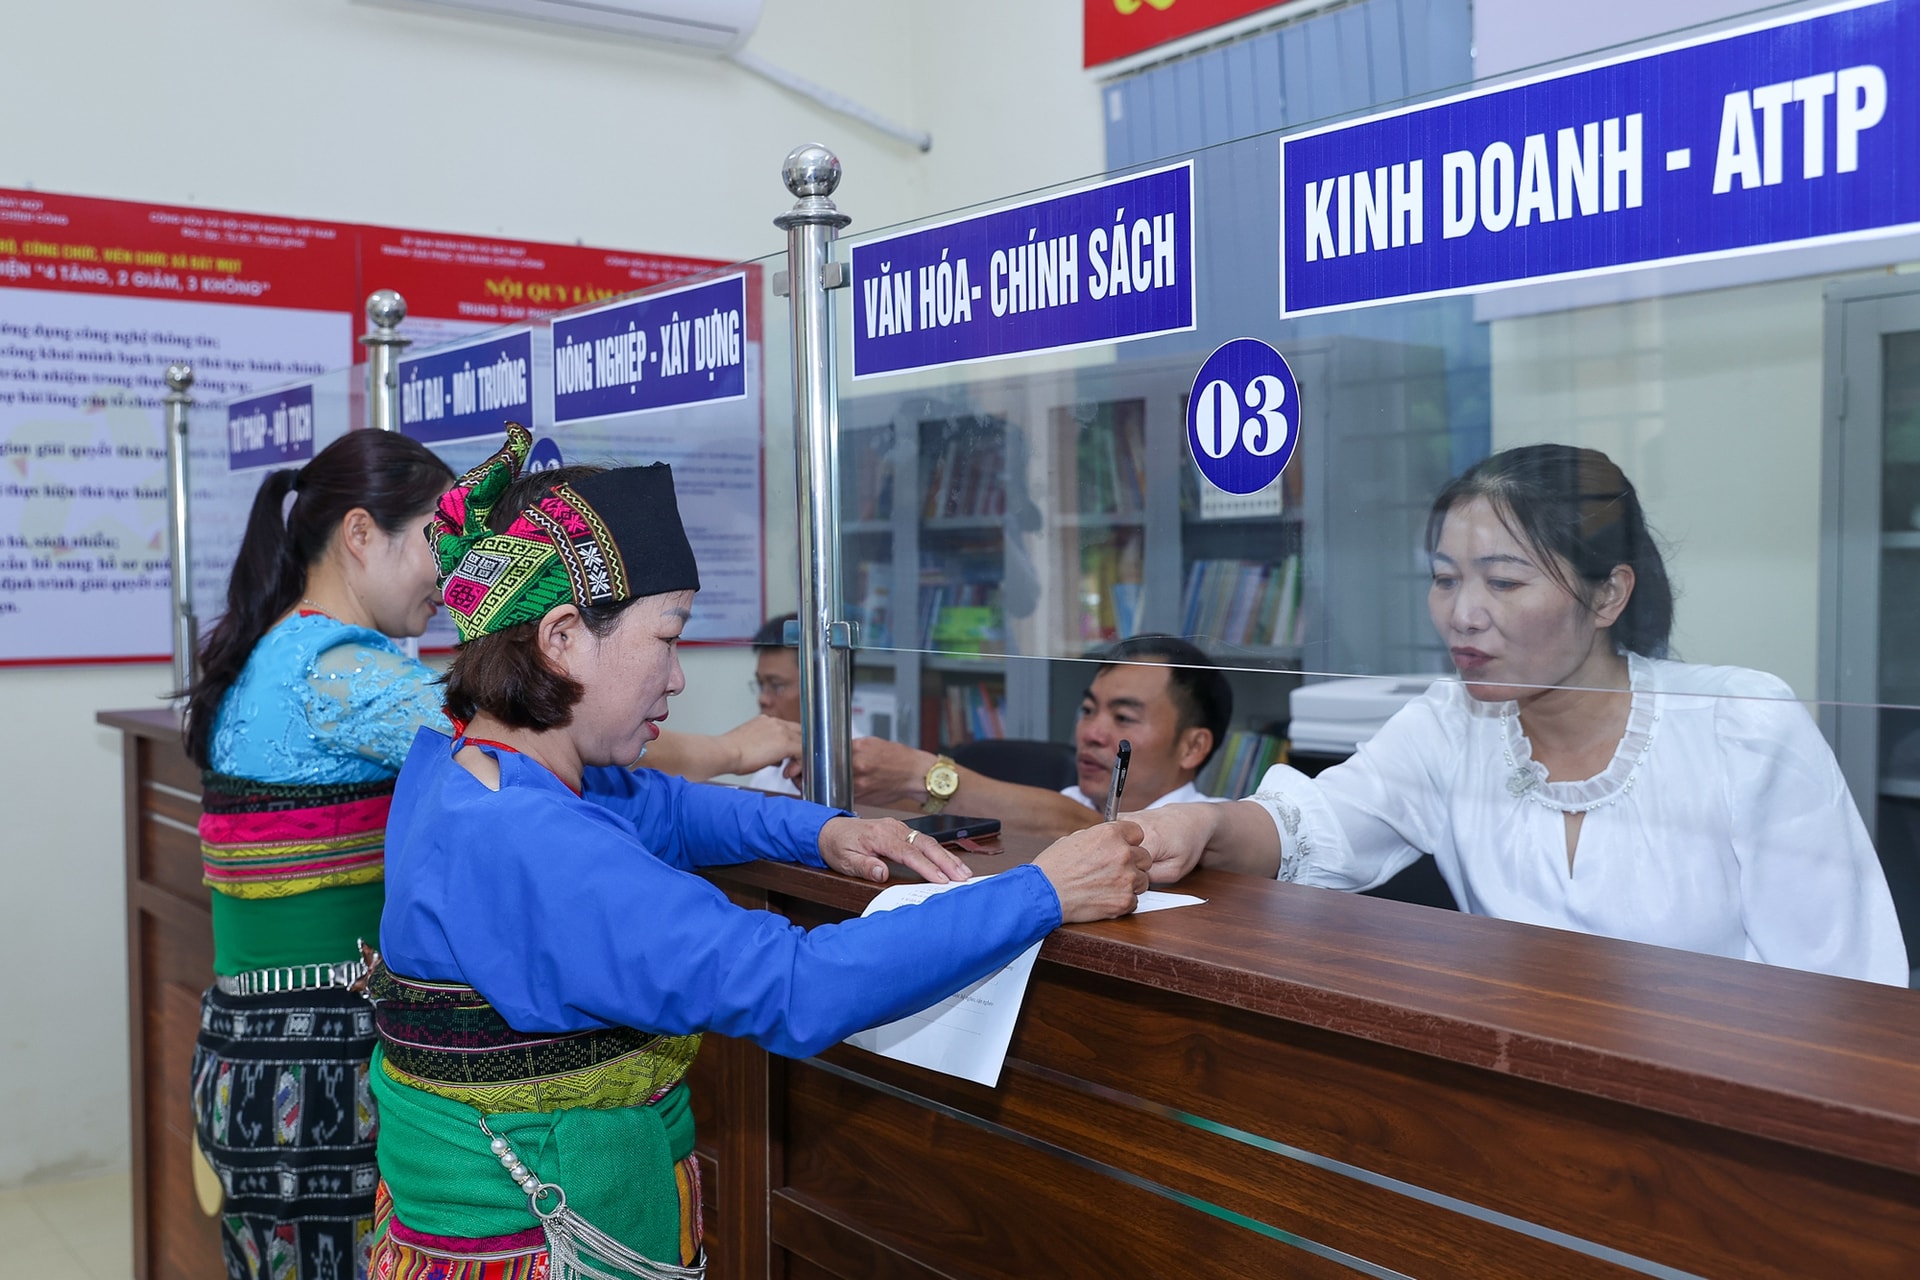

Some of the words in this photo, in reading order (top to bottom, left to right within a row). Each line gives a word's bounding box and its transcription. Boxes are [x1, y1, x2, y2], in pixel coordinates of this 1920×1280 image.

[1303, 159, 1424, 263] KINH
[1442, 112, 1644, 240] DOANH
[1665, 148, 1692, 174] -
[1711, 64, 1888, 195] ATTP
[59, 262, 114, 288] TĂNG,
[117, 269, 129, 287] 2
[131, 268, 184, 293] GIẢM,
[186, 275, 198, 292] 3
[458, 301, 499, 317] TRUNG
[485, 276, 523, 303] NỘI
[526, 282, 568, 304] QUY
[863, 260, 913, 339] VĂN
[990, 227, 1079, 318] CHÍNH
[1088, 207, 1176, 300] SÁCH
[402, 366, 423, 423] ĐẤT
[424, 376, 444, 421] ĐAI
[445, 394, 451, 404] -
[453, 361, 476, 416] MÔI
[477, 351, 527, 412] TRƯỜNG
[556, 334, 593, 395] NÔNG
[595, 321, 647, 394] NGHIỆP
[650, 351, 658, 363] -
[660, 311, 690, 377] XÂY
[694, 308, 740, 381] DỰNG
[273, 400, 288, 453] HỘ
[288, 403, 312, 451] TỊCH
[1195, 373, 1291, 459] 03
